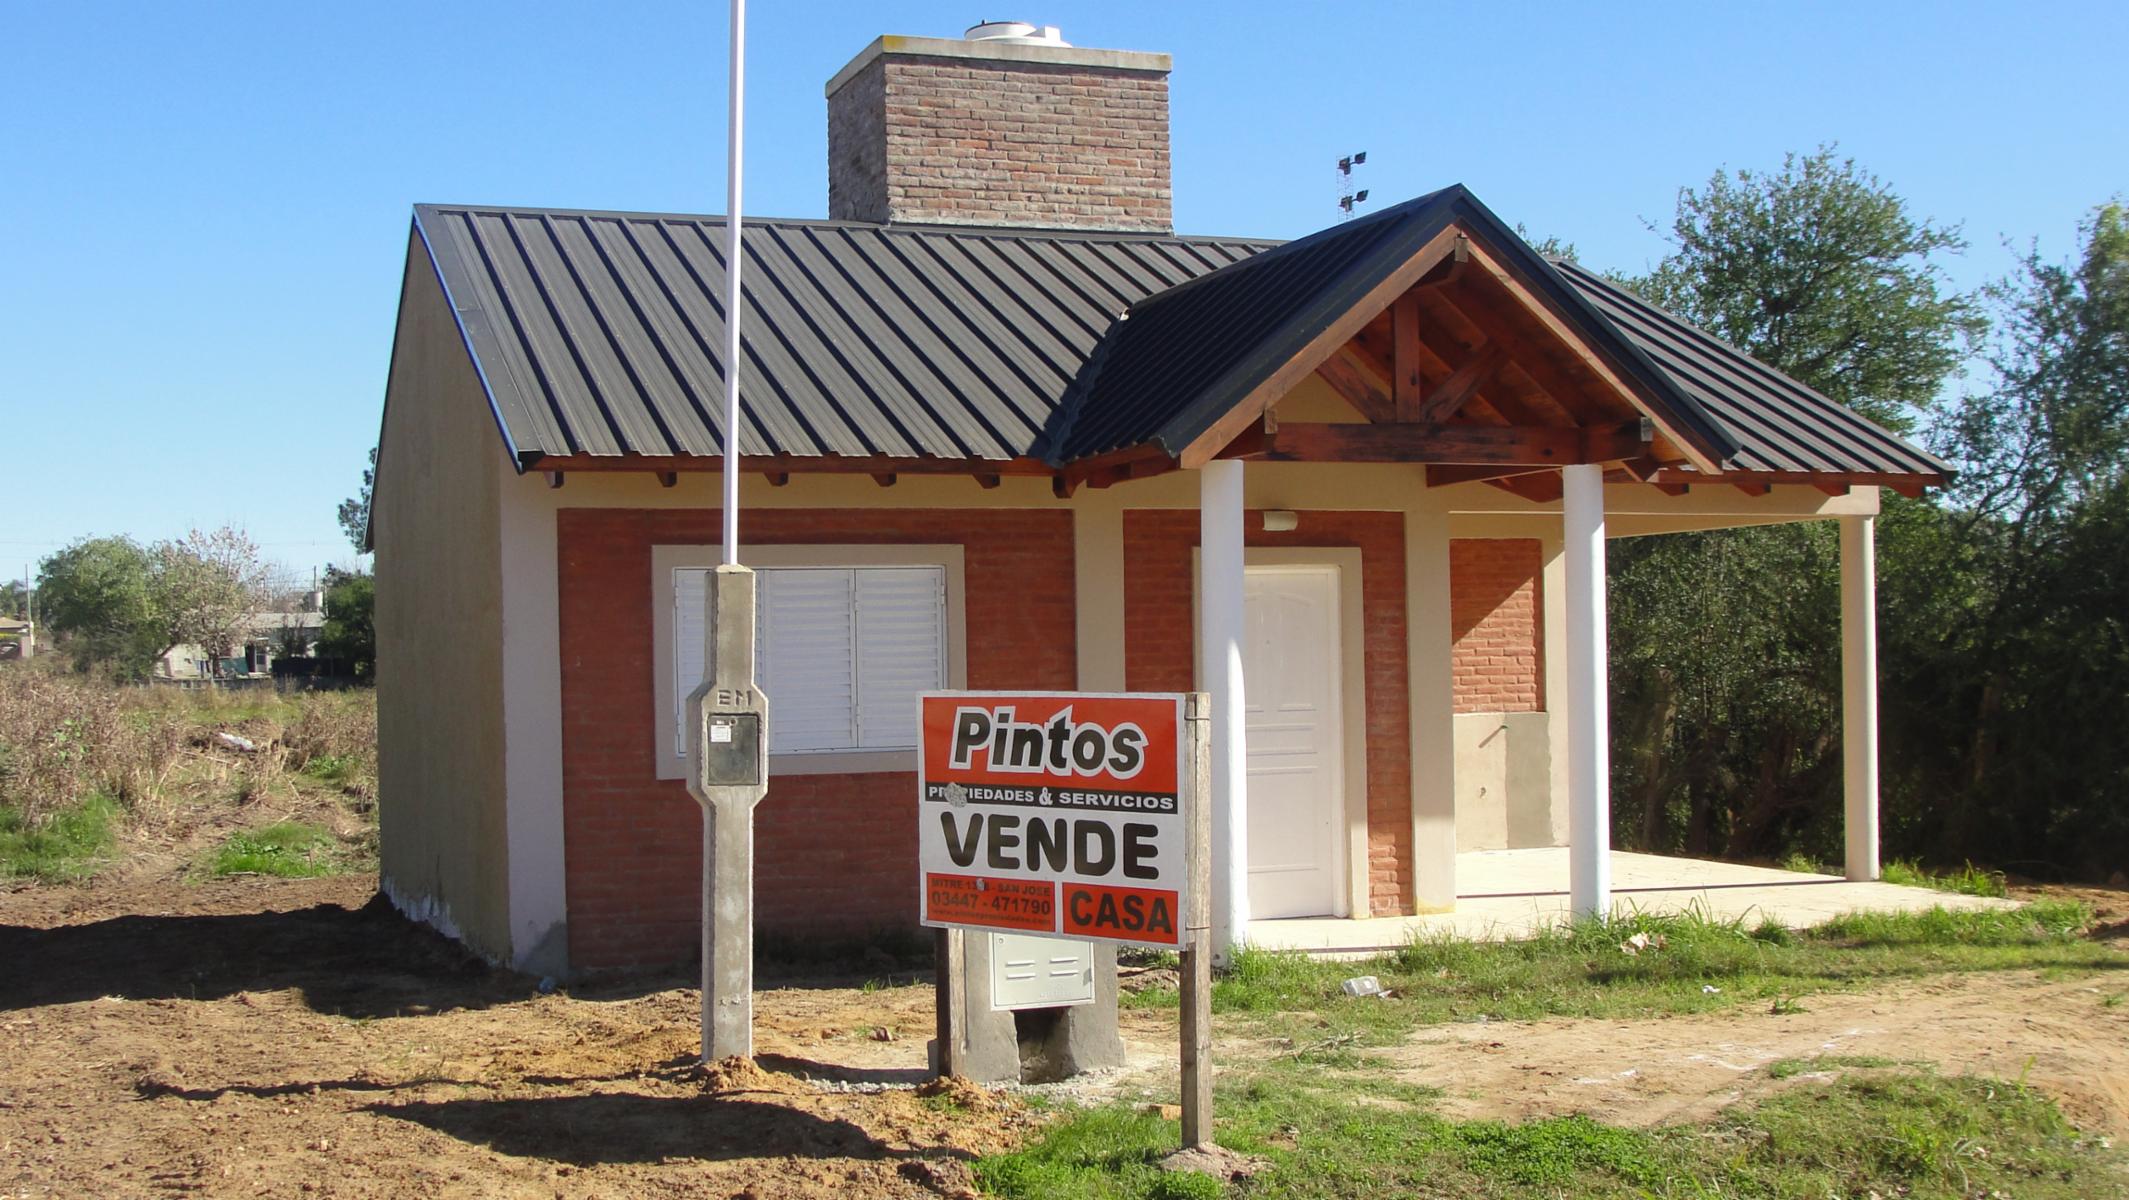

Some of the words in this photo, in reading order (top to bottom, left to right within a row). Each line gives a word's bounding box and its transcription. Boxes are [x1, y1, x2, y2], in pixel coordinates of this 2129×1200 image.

[950, 705, 1148, 779] Pintos
[1038, 787, 1053, 806] &
[1058, 790, 1174, 810] SERVICIOS
[940, 811, 1159, 880] VENDE
[931, 878, 962, 890] MITRE
[997, 883, 1020, 895] SAN
[931, 891, 978, 909] 03447
[991, 895, 1051, 915] 471790
[1070, 890, 1173, 935] CASA
